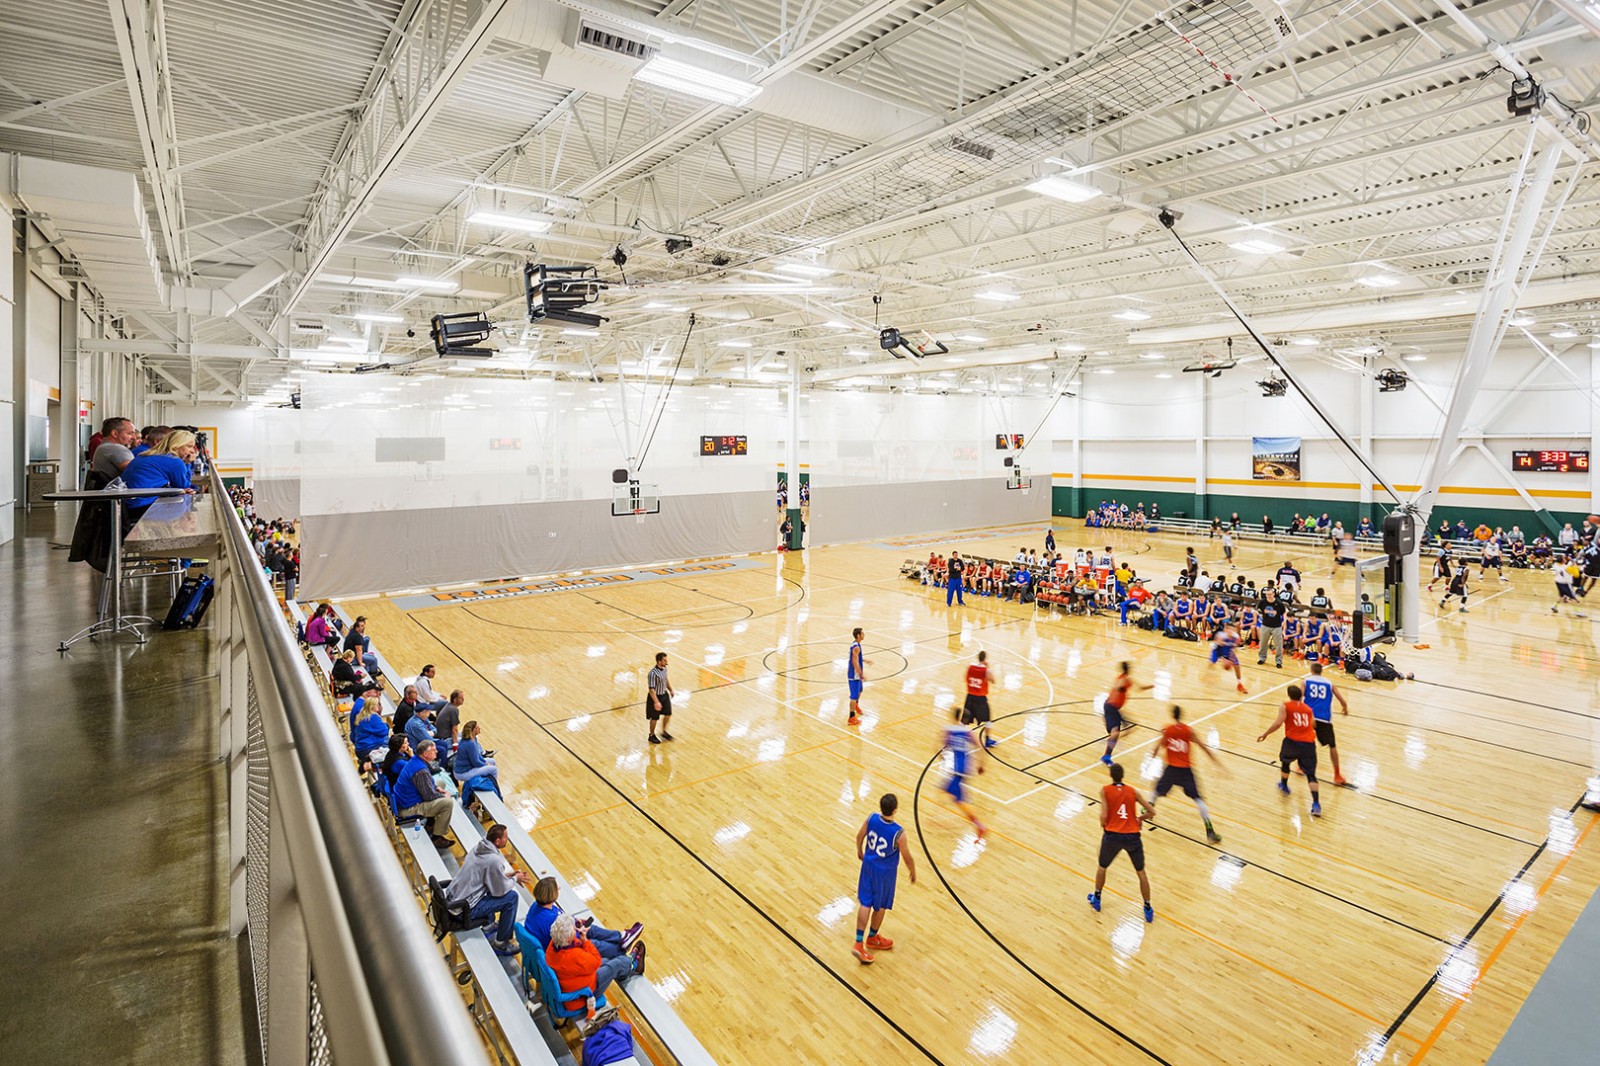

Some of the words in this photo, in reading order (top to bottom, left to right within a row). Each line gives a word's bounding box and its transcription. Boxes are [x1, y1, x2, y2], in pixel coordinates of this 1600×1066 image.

[704, 441, 714, 451] 20
[1520, 457, 1532, 466] 14
[1540, 451, 1567, 462] 3:33
[1560, 464, 1568, 472] 2
[1575, 457, 1588, 468] 16
[1313, 597, 1327, 606] 20
[1309, 683, 1327, 700] 33
[1292, 711, 1309, 728] 33
[1116, 803, 1129, 820] 4
[867, 829, 889, 858] 32
